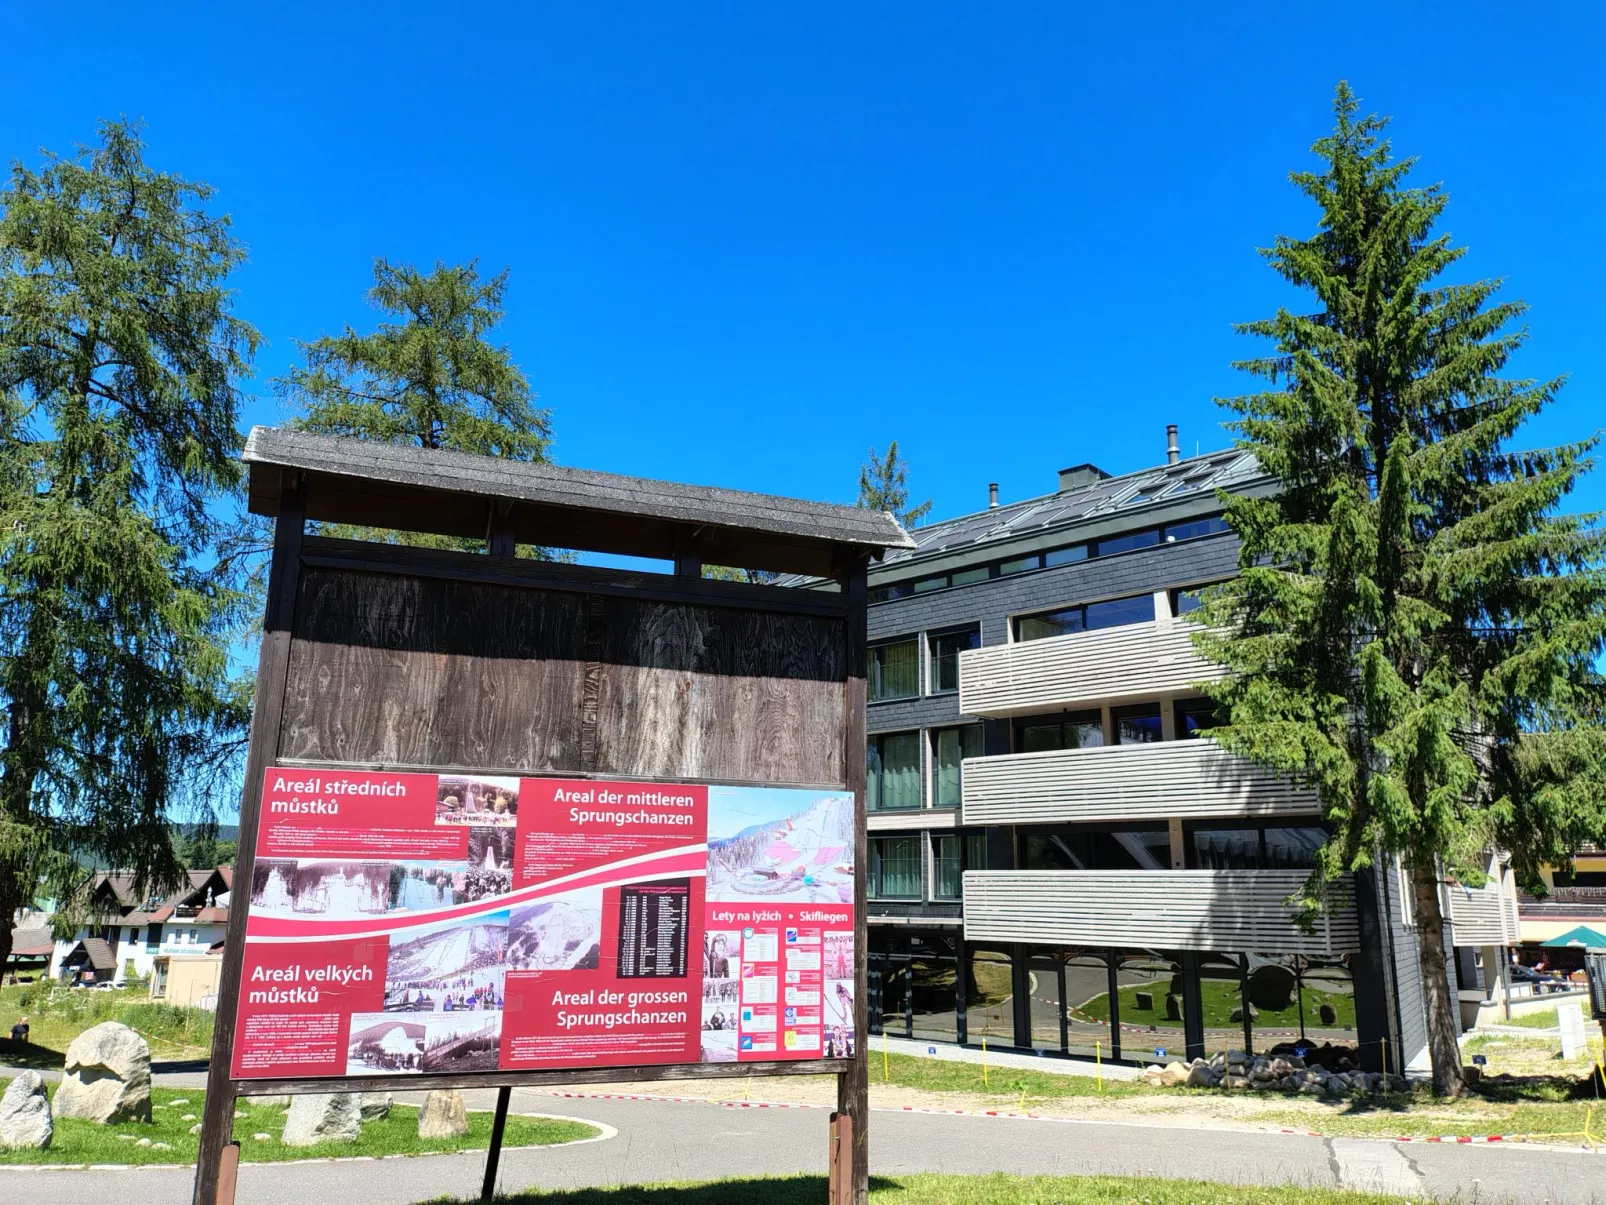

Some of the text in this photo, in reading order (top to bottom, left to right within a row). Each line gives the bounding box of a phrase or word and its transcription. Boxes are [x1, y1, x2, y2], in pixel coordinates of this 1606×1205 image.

[272, 777, 407, 797] Areál středních
[270, 796, 339, 815] můstků
[553, 788, 694, 807] Areal der mittleren
[569, 807, 694, 827] Sprungschanzen
[712, 910, 849, 924] Lety na lyžích Skifliegen
[250, 964, 373, 986] Areál velkých
[248, 985, 319, 1004] můstků
[551, 988, 688, 1008] Areal der grossen
[556, 1008, 687, 1030] Sprungschanzen
